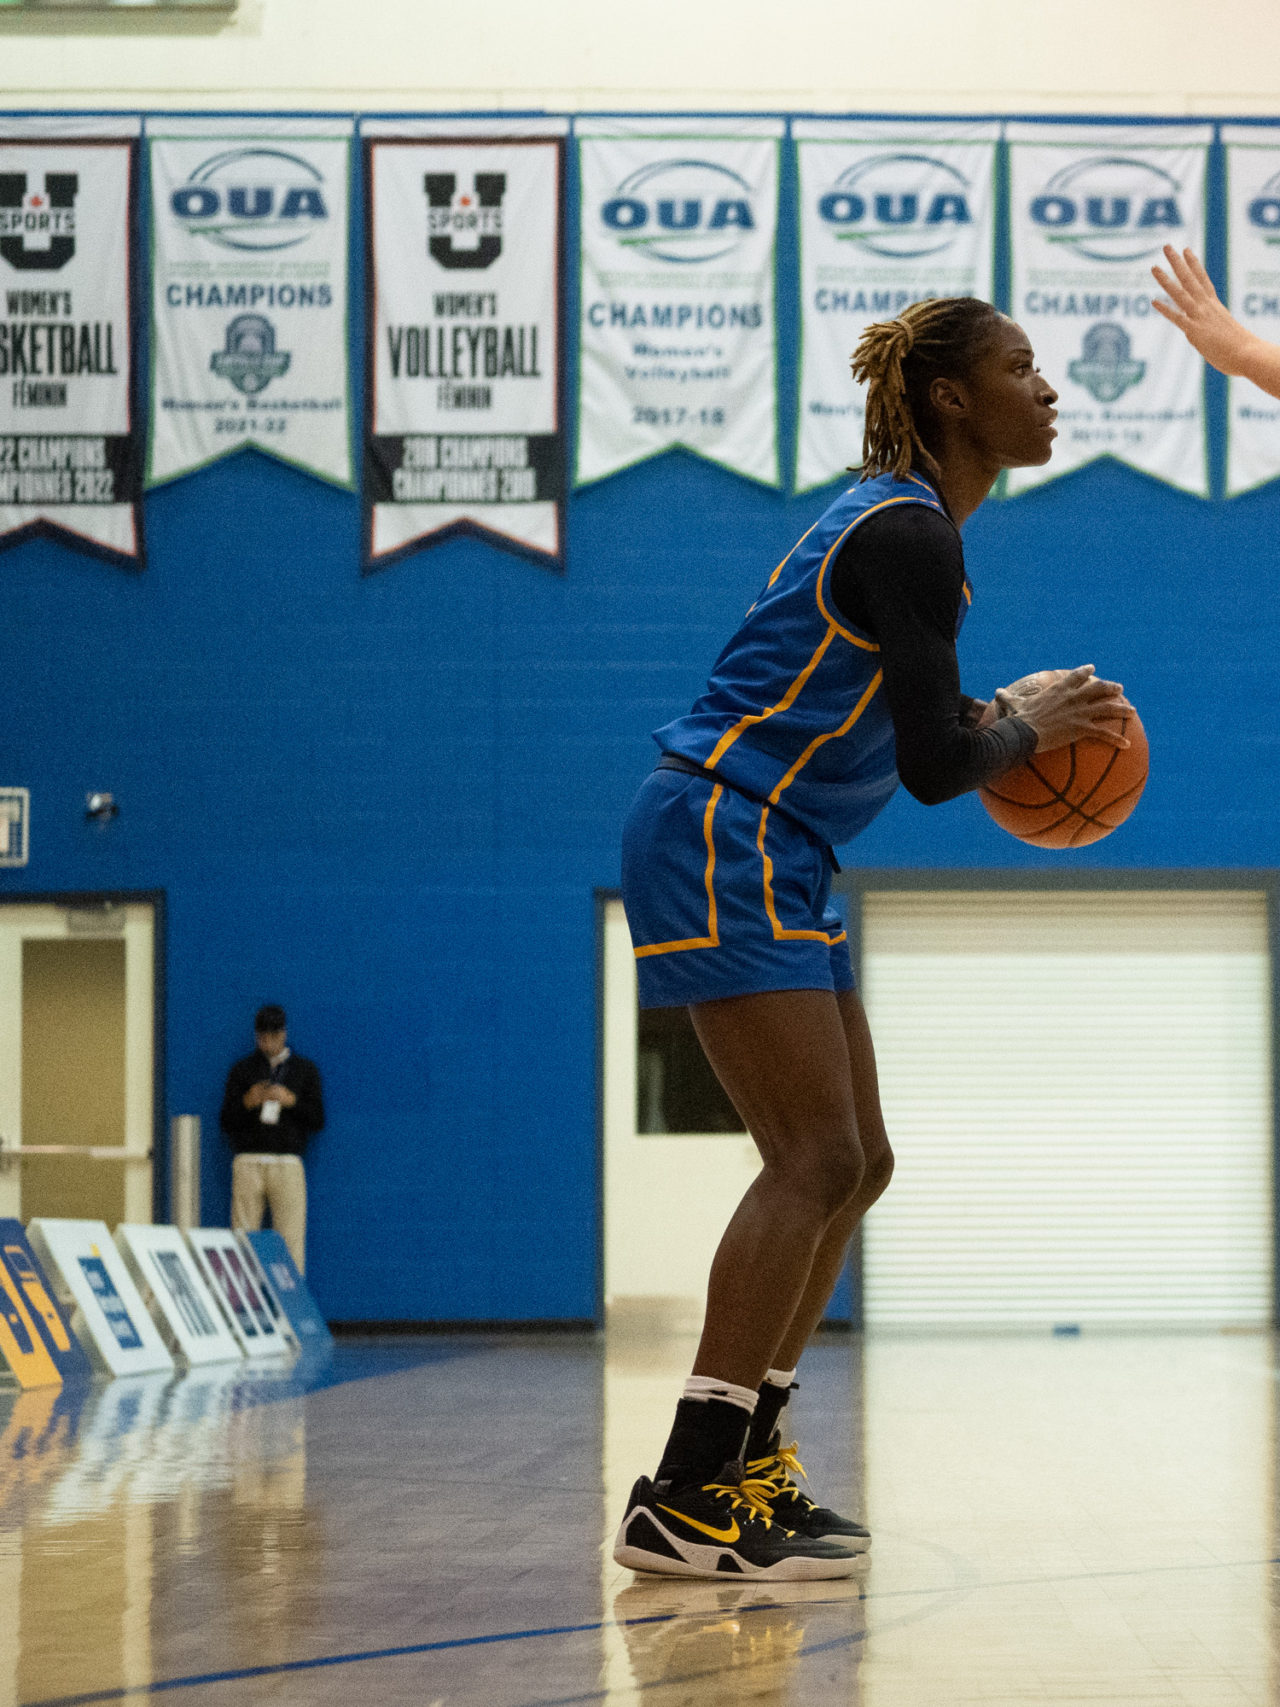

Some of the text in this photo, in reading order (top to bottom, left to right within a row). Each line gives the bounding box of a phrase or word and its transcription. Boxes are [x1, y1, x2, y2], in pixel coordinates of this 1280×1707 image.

[170, 187, 329, 220] OUA
[600, 199, 756, 230] OUA
[819, 192, 973, 225] OUA
[1029, 196, 1182, 227] OUA
[0, 209, 76, 232] SPORTS
[427, 209, 503, 232] SPORTS
[6, 291, 72, 315] WOMEN'S
[167, 283, 332, 307] CHAMPIONS
[433, 292, 496, 316] WOMEN'S
[1024, 291, 1172, 316] CHAMPIO
[587, 304, 762, 328] CHAMPIONS
[388, 326, 541, 377] VOLLEYBALL
[633, 342, 722, 356] Women's
